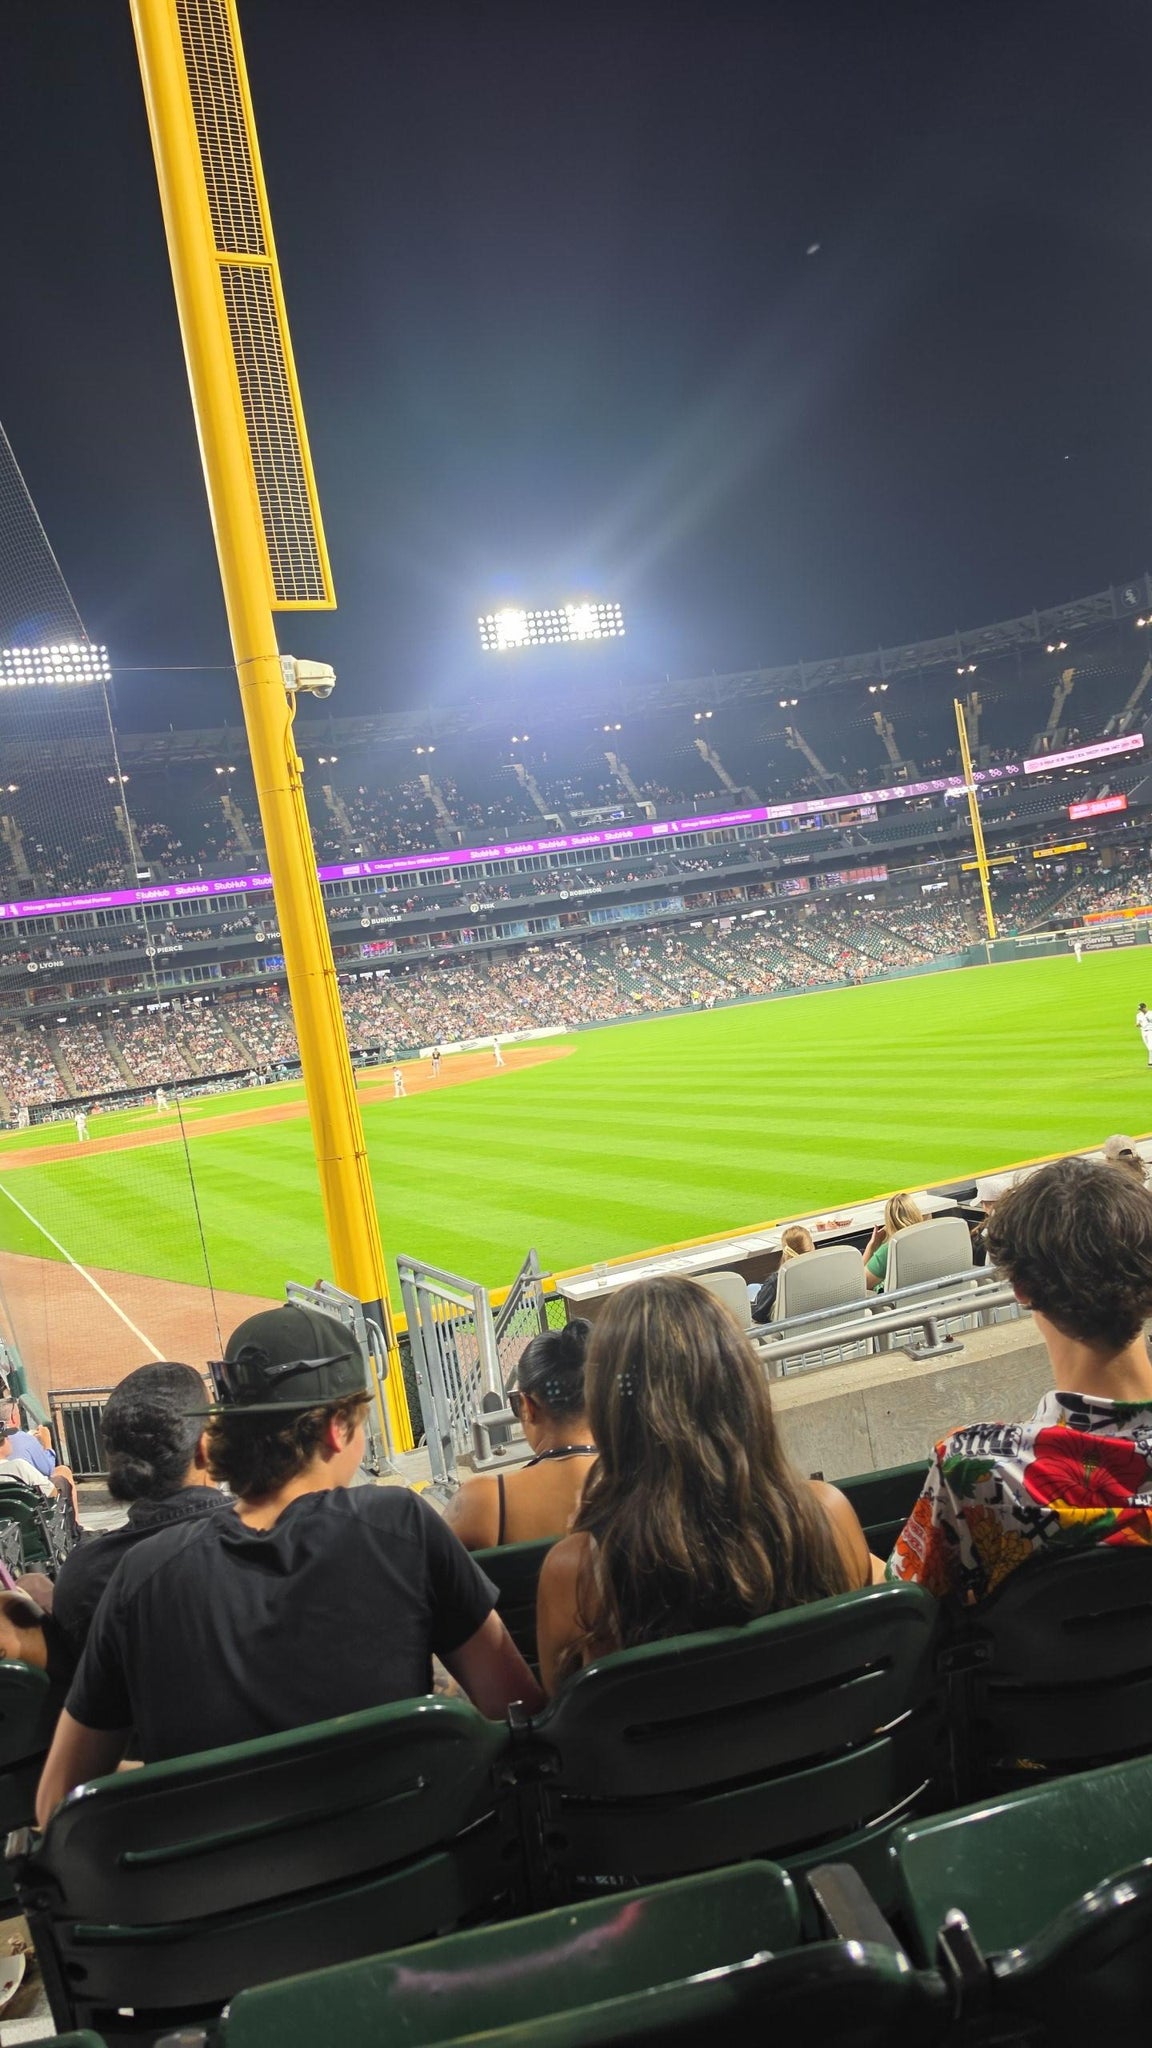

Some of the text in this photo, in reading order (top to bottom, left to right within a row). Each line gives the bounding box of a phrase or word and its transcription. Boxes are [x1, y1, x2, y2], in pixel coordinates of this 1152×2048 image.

[175, 885, 209, 896] StubHub
[214, 880, 247, 891] StubHub
[136, 889, 170, 900] StubHub
[570, 888, 602, 897] ROBINSON
[371, 915, 402, 925] BUEHRLE
[157, 945, 183, 954] PIERCE
[39, 960, 64, 969] LYONS
[949, 1427, 1020, 1457] STYLE
